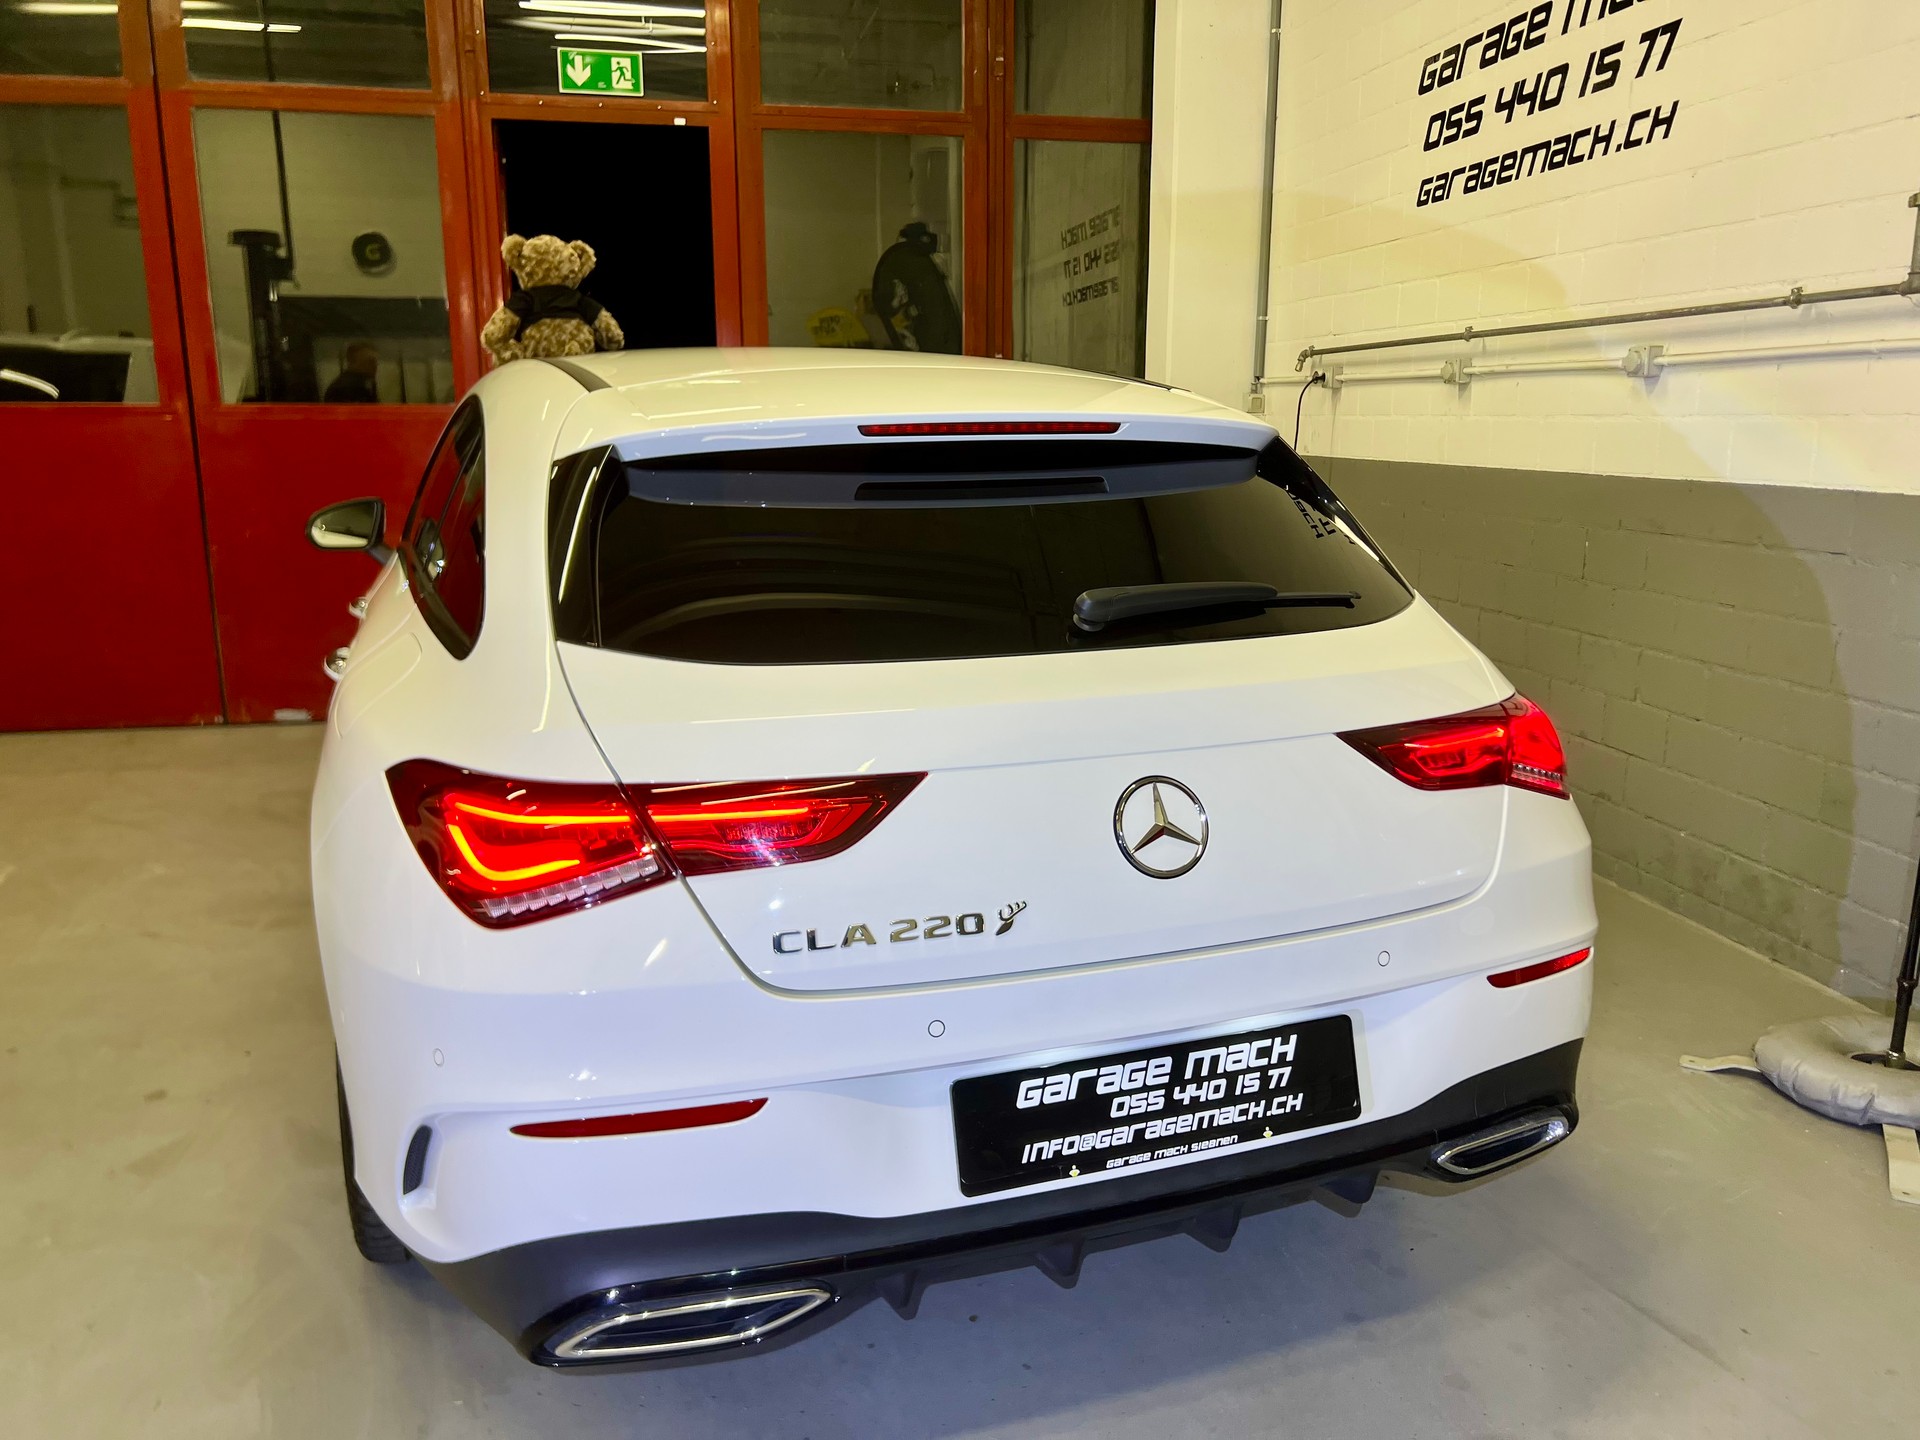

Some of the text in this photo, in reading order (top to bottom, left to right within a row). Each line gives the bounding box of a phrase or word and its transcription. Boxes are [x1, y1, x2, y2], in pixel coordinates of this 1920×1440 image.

[1423, 18, 1683, 152] 055 440 15 77
[772, 912, 985, 955] CLA 220
[1110, 1066, 1293, 1118] 055 440 15 77
